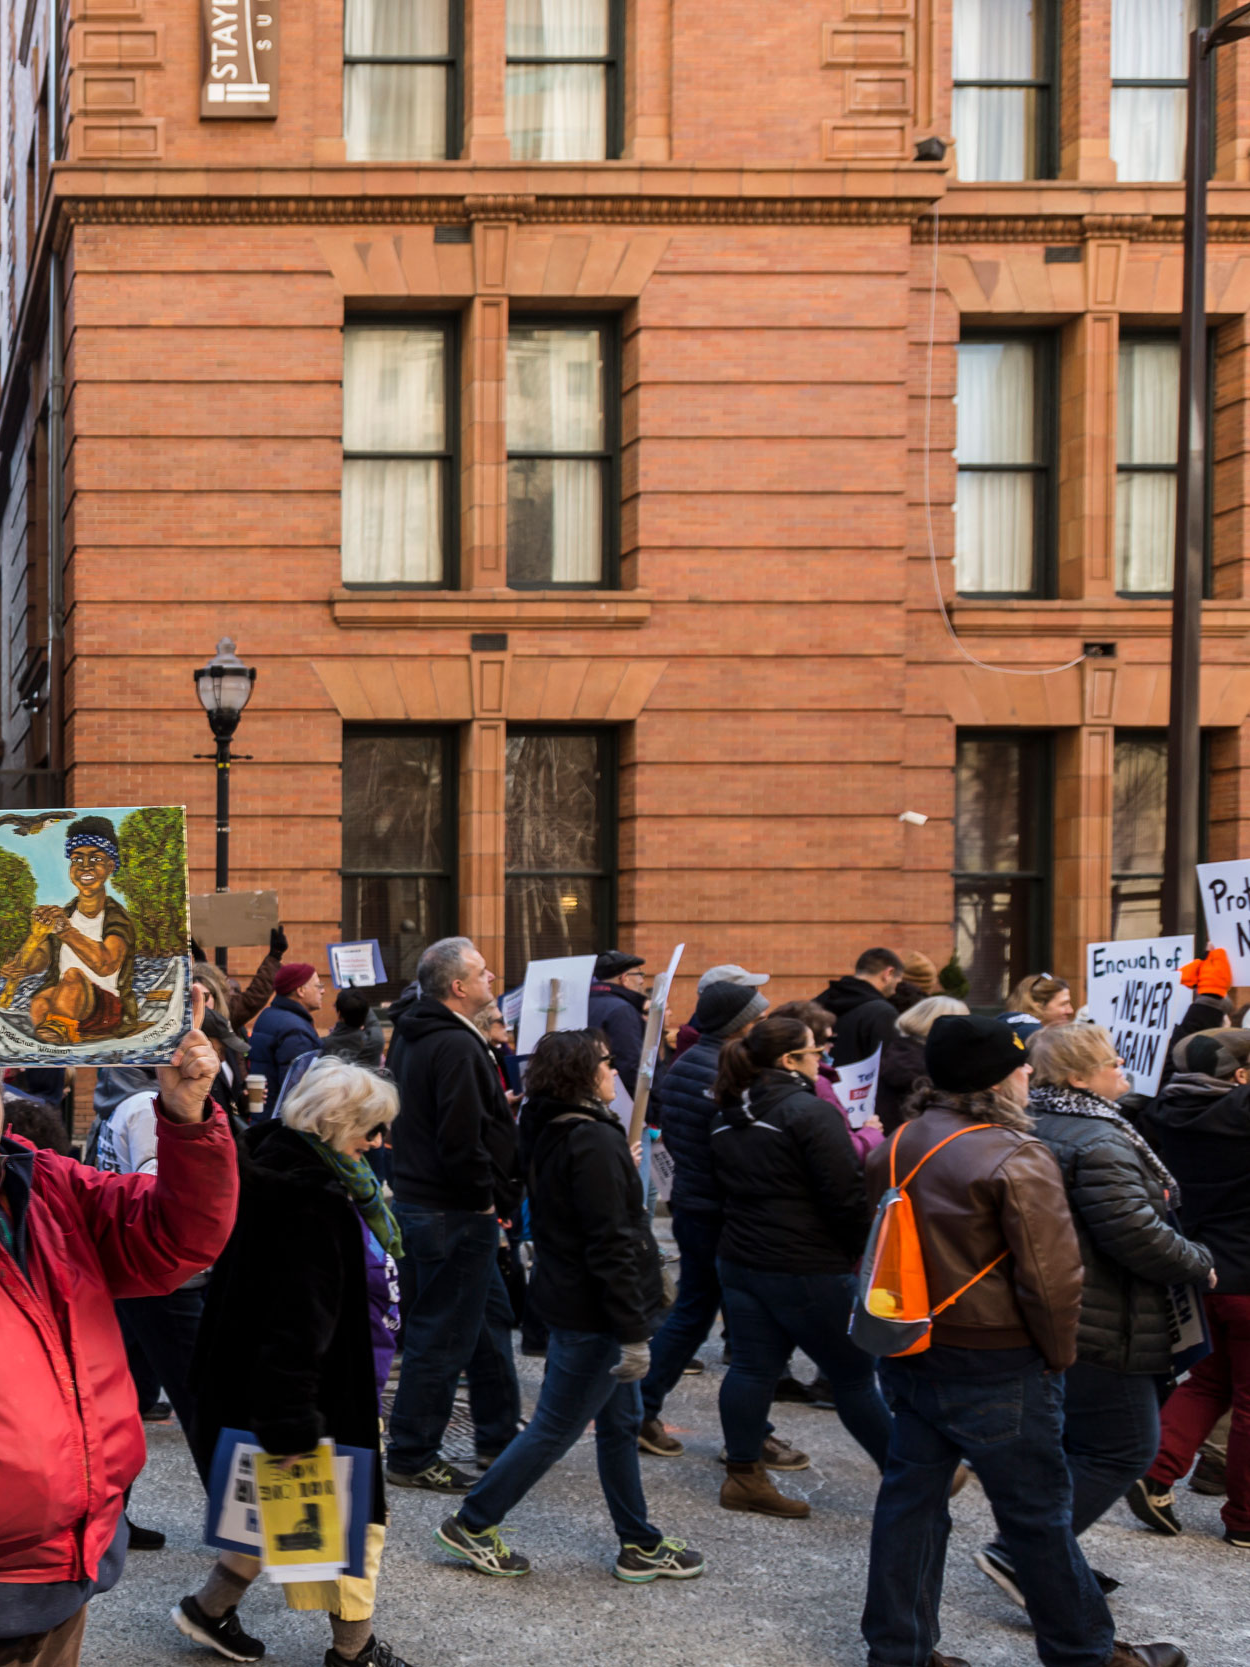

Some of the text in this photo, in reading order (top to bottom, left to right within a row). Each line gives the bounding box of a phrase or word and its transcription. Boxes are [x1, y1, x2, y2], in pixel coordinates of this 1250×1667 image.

[211, 0, 238, 79] STAY
[256, 0, 272, 50] SU
[1165, 946, 1182, 972] of
[1120, 980, 1173, 1030] NEVER
[1115, 1030, 1161, 1077] AGAIN
